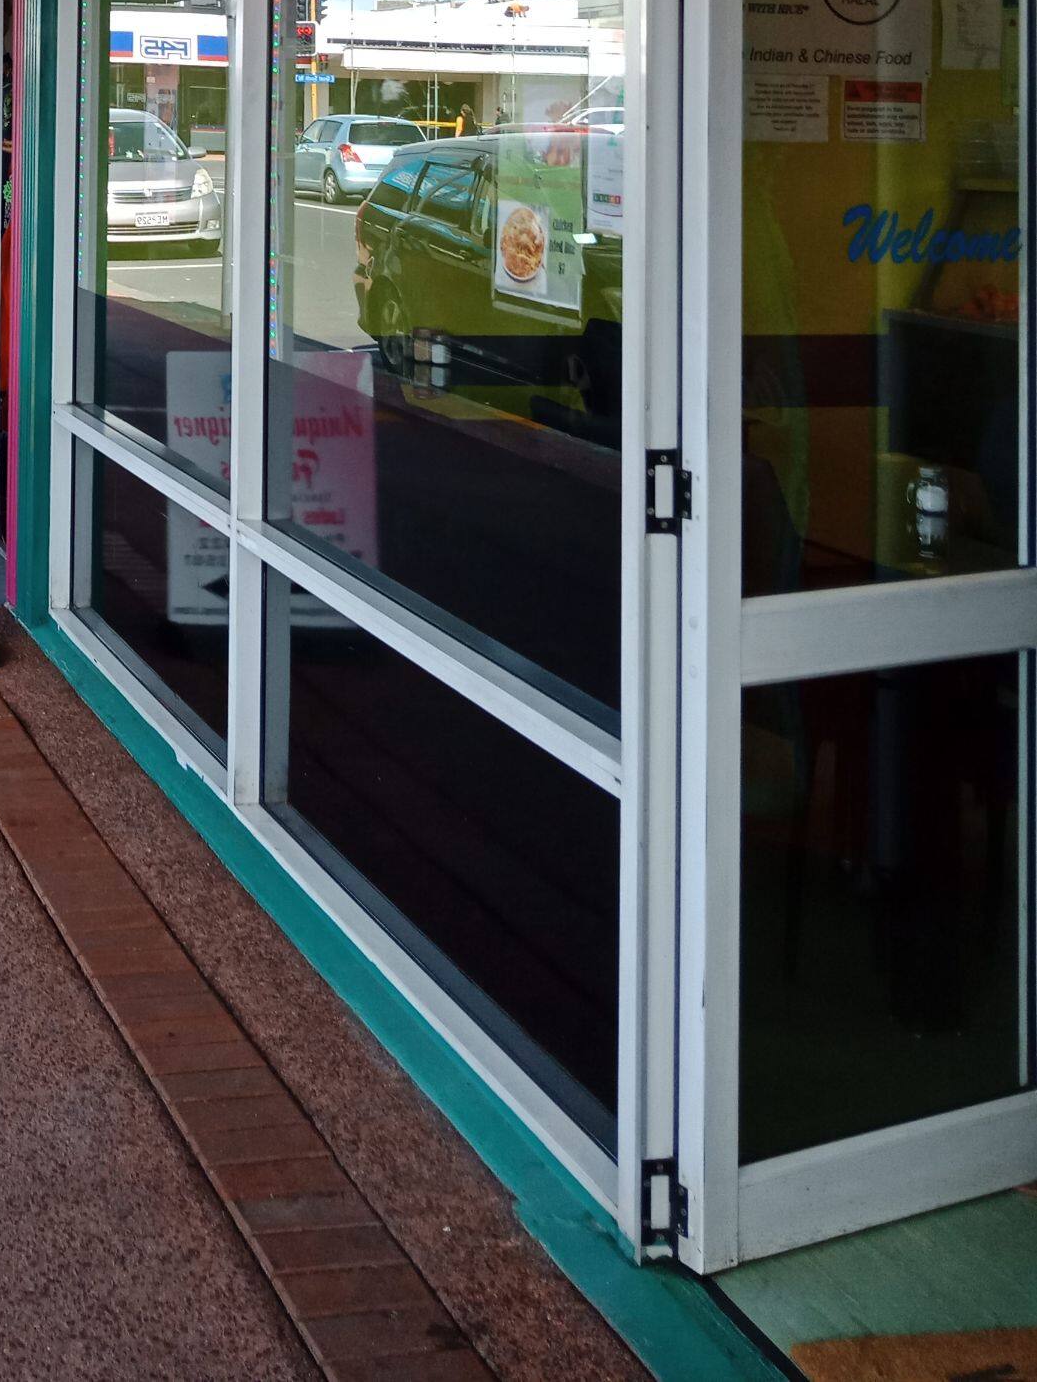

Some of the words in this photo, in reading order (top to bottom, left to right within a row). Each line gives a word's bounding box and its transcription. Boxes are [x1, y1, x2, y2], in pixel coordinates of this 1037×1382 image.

[750, 48, 793, 63] Indian
[799, 48, 809, 63] &
[814, 49, 870, 65] Chinese
[876, 51, 912, 65] Food
[843, 204, 1020, 264] Welcome
